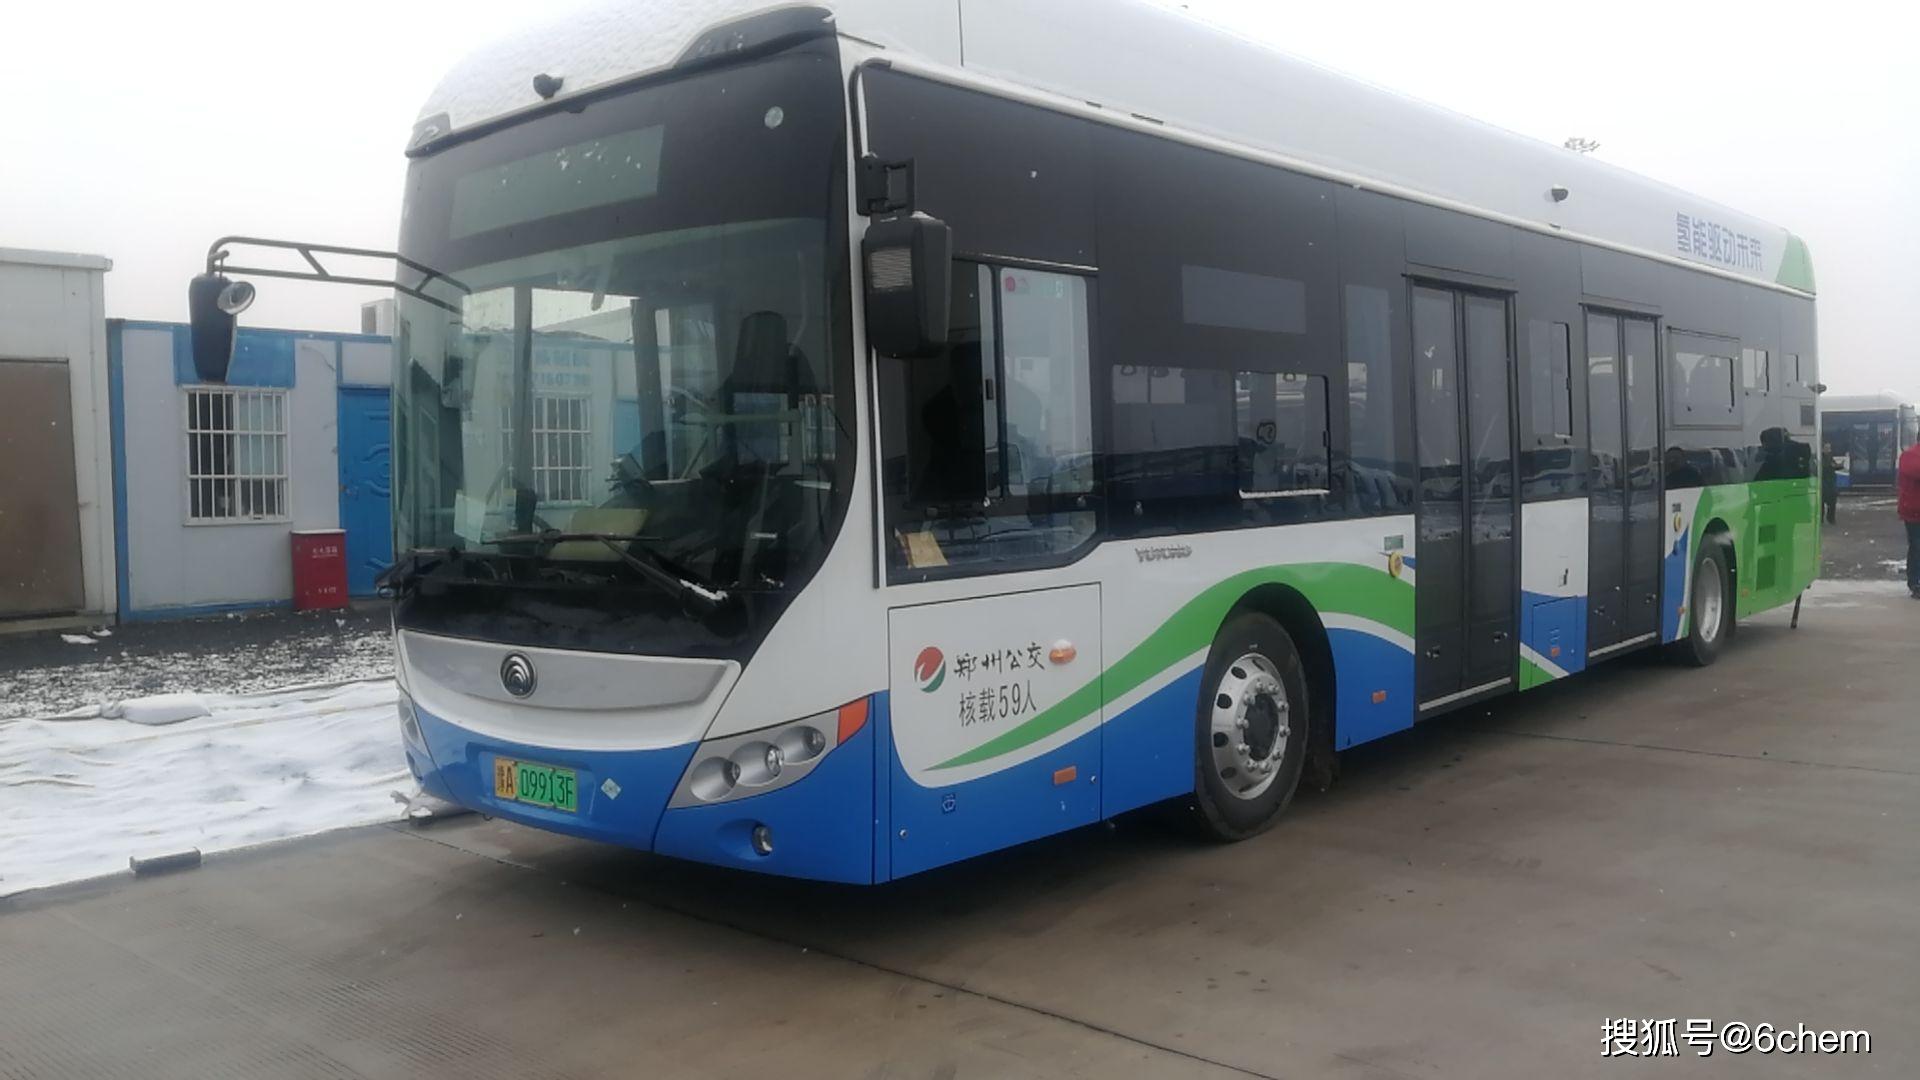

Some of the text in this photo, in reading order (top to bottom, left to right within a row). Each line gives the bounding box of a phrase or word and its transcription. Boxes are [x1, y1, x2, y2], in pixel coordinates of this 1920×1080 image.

[953, 641, 1045, 681] 郑州公交
[958, 679, 1037, 727] 核载59人
